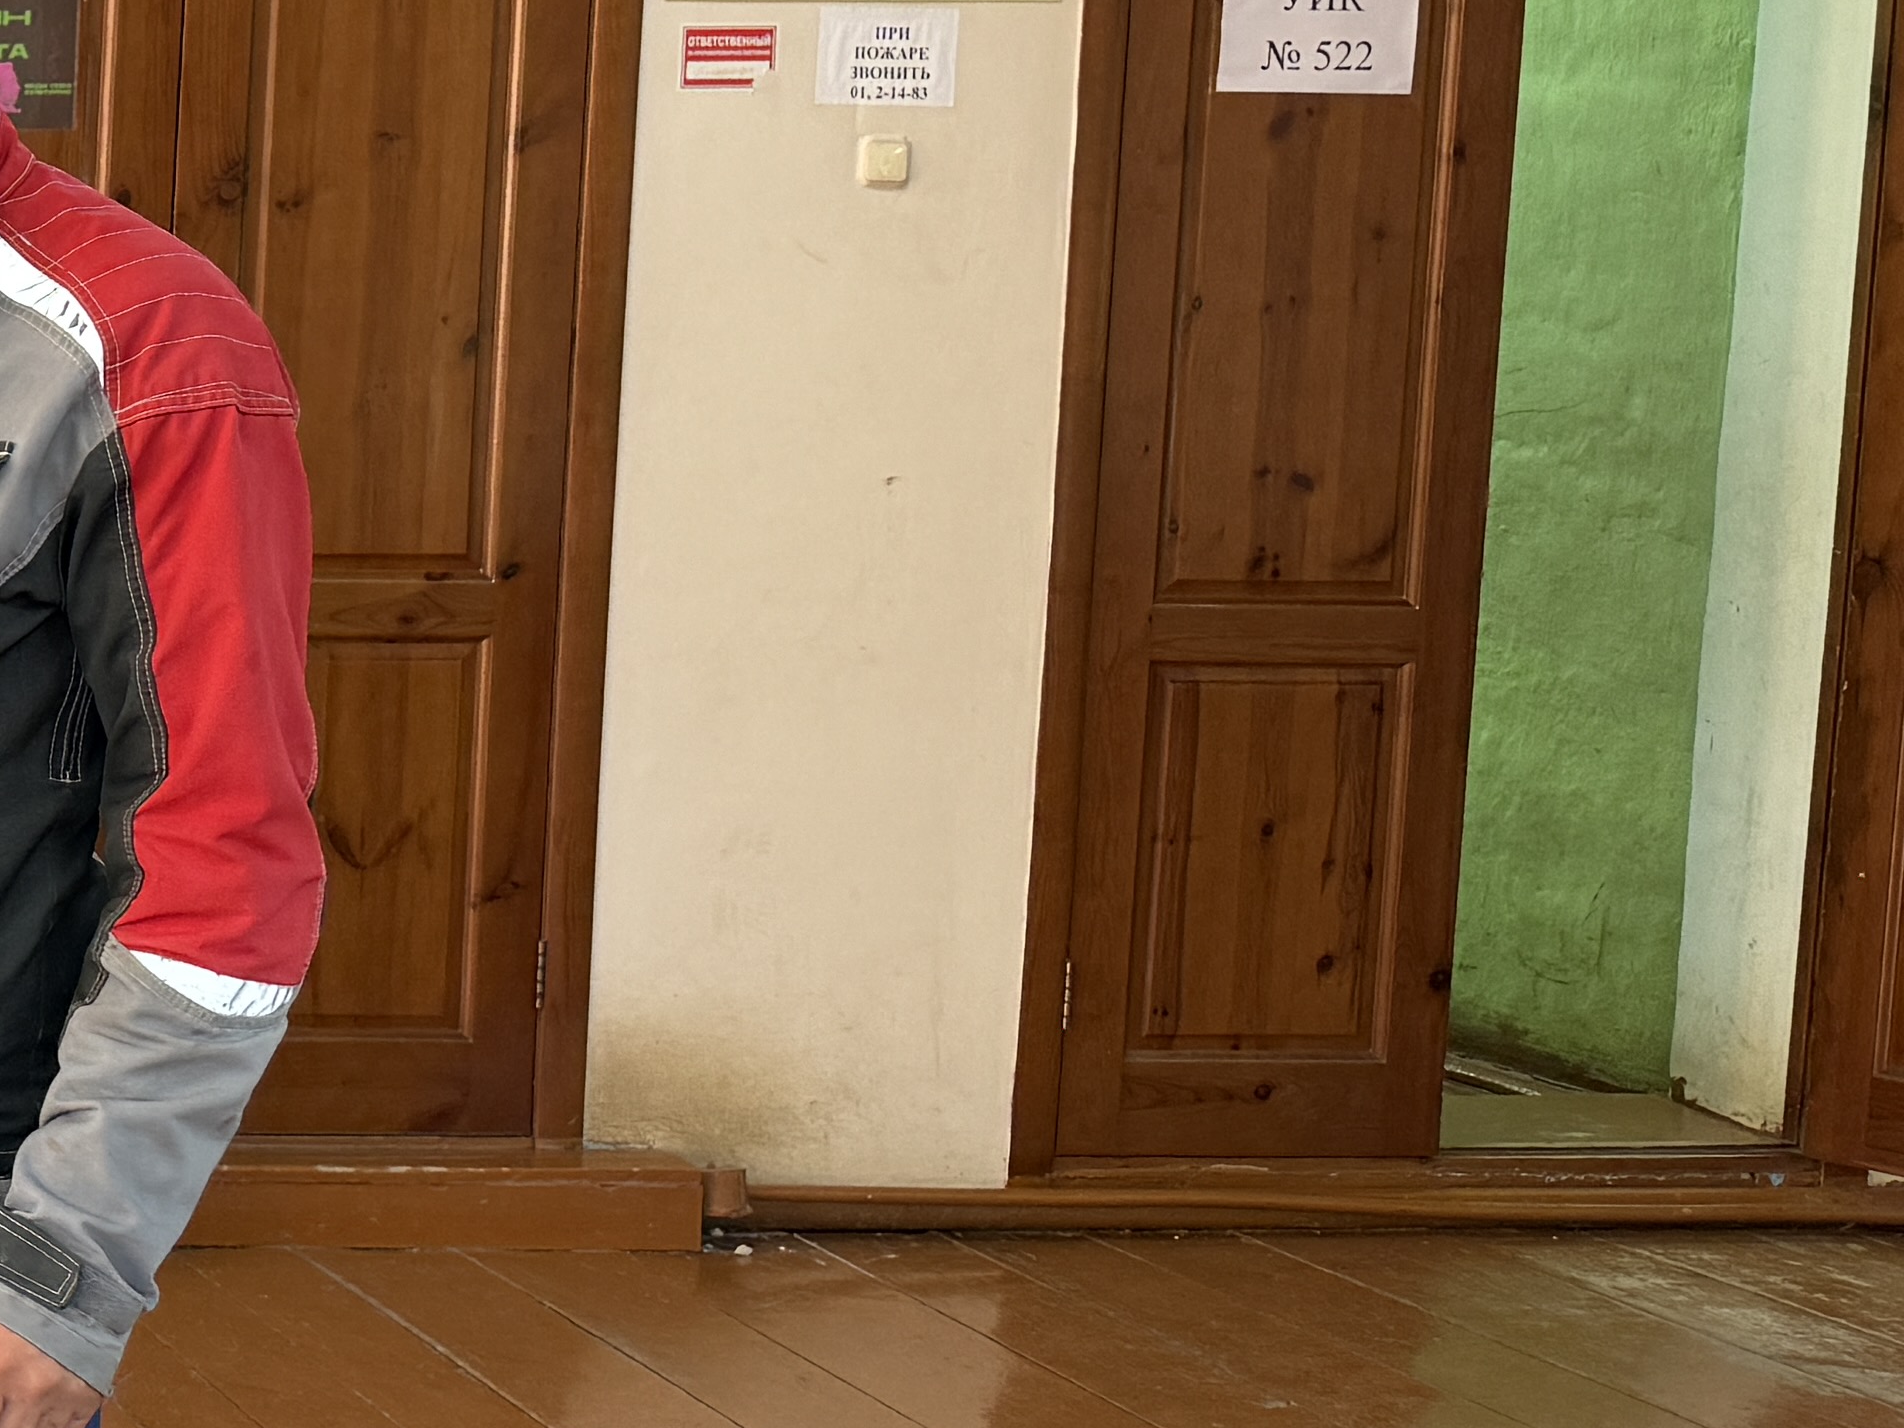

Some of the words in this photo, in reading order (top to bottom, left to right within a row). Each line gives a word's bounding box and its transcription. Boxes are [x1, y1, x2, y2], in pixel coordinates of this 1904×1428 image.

[687, 33, 771, 48] ОТВЕТСТВЕННЫЙ
[875, 26, 910, 41] ПРИ
[854, 46, 930, 60] ПОЖАРЕ
[1261, 39, 1300, 71] №
[1313, 39, 1373, 71] 522
[850, 66, 931, 80] ЗВОНИТЬ
[850, 85, 872, 101] 01,
[875, 86, 928, 101] 2-14-83
